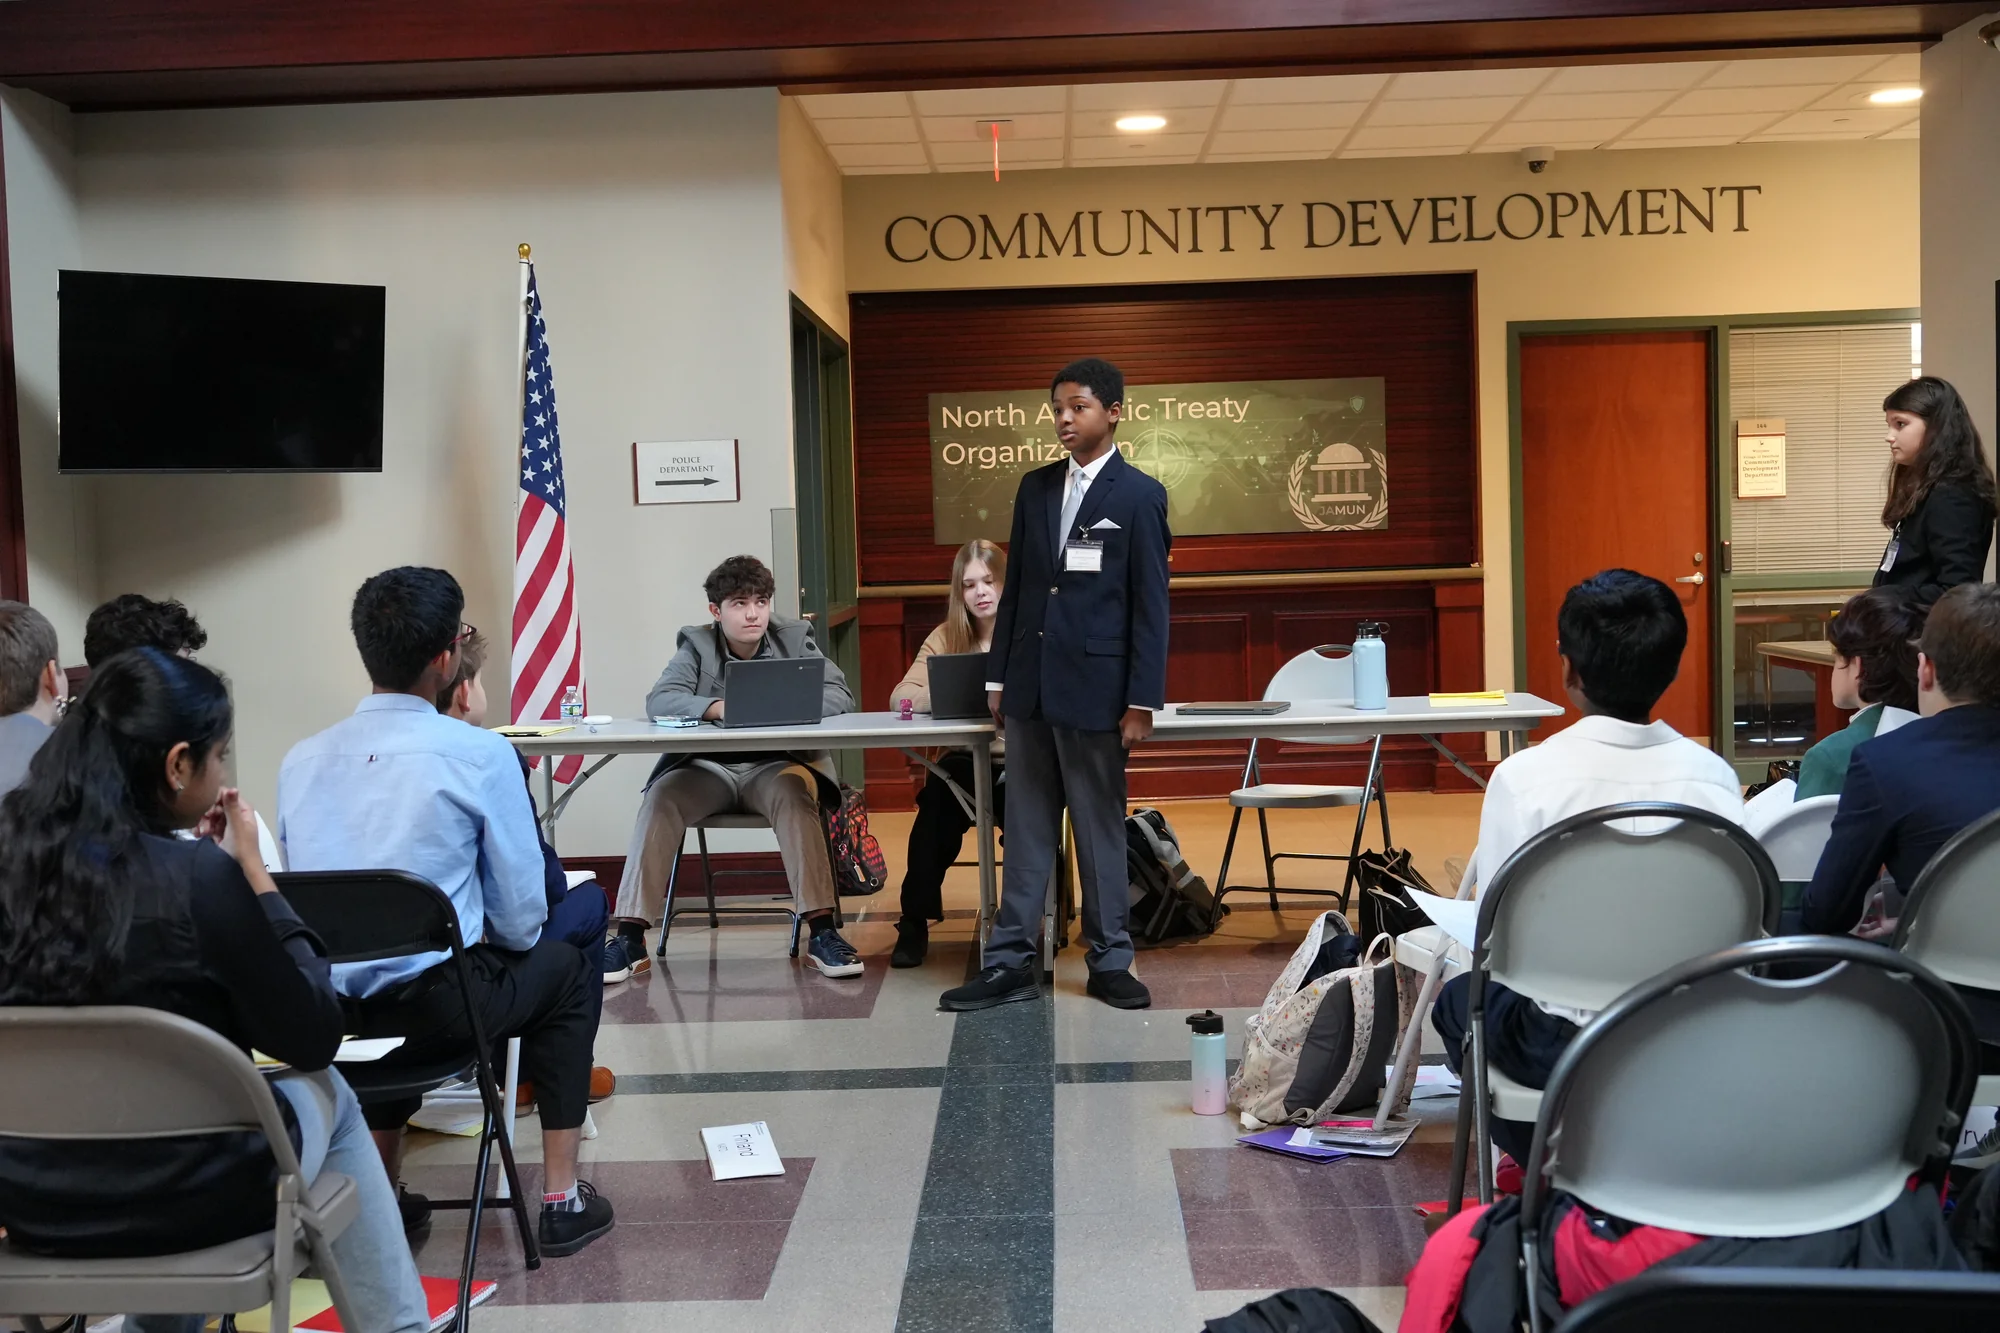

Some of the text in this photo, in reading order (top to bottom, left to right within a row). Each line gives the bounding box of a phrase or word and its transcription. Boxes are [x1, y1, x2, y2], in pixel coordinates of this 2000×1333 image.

[885, 185, 1762, 263] COMMUNITY DEVELOPMENT
[941, 402, 1026, 429] North
[1158, 396, 1251, 424] Treaty
[672, 456, 701, 464] POLICE
[941, 437, 1135, 470] Organizan
[659, 465, 715, 474] DEPARTMENT
[1319, 504, 1366, 516] JAMUN
[733, 1133, 760, 1157] Finland
[543, 1192, 566, 1203] UMA
